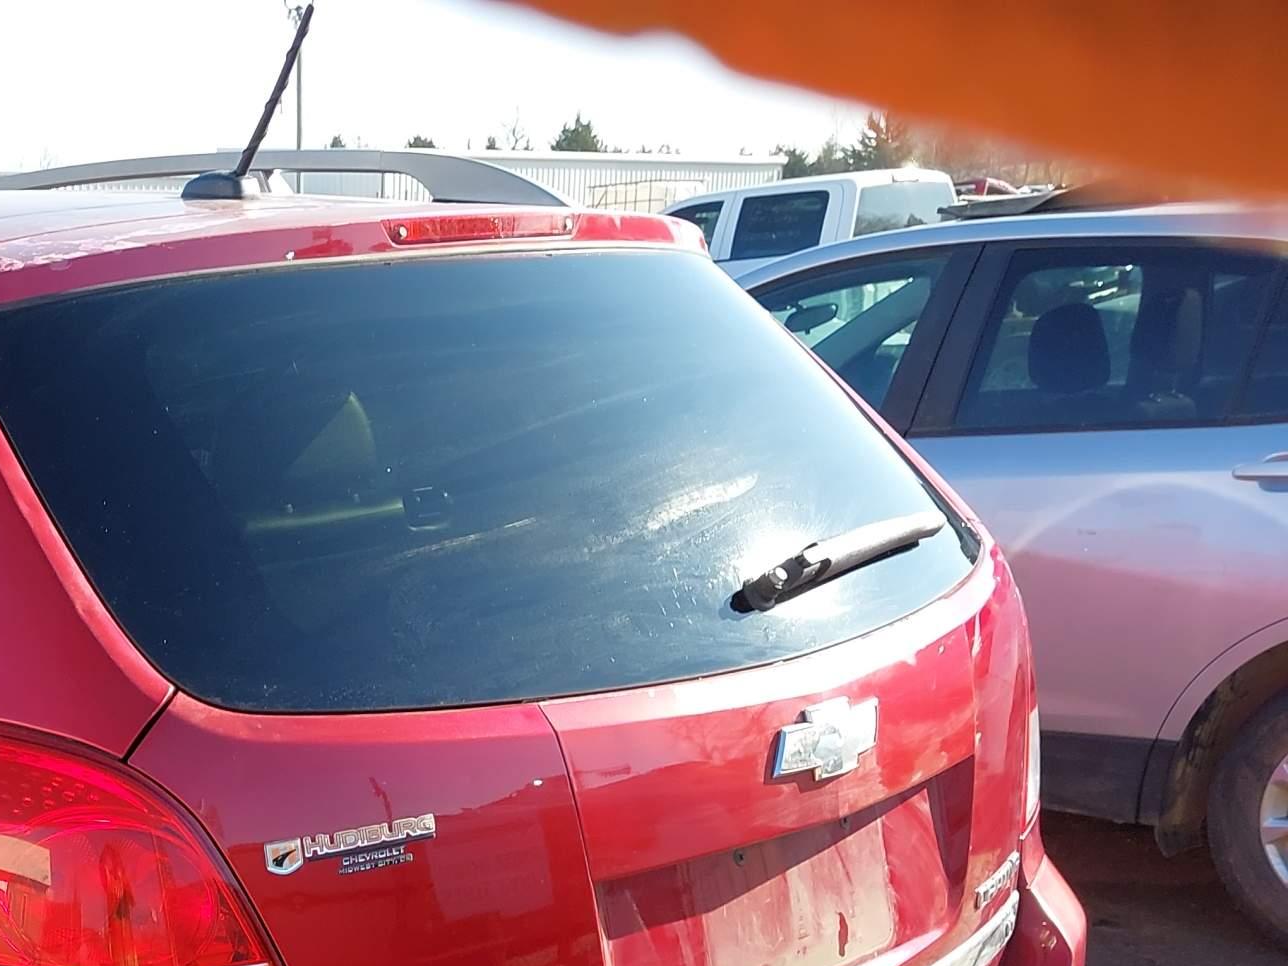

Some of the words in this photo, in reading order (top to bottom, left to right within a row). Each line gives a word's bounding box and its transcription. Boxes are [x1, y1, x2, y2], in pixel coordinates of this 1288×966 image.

[303, 813, 435, 858] HUDIBURG
[342, 846, 405, 865] CHEVROLET
[338, 862, 376, 875] MIDWEST
